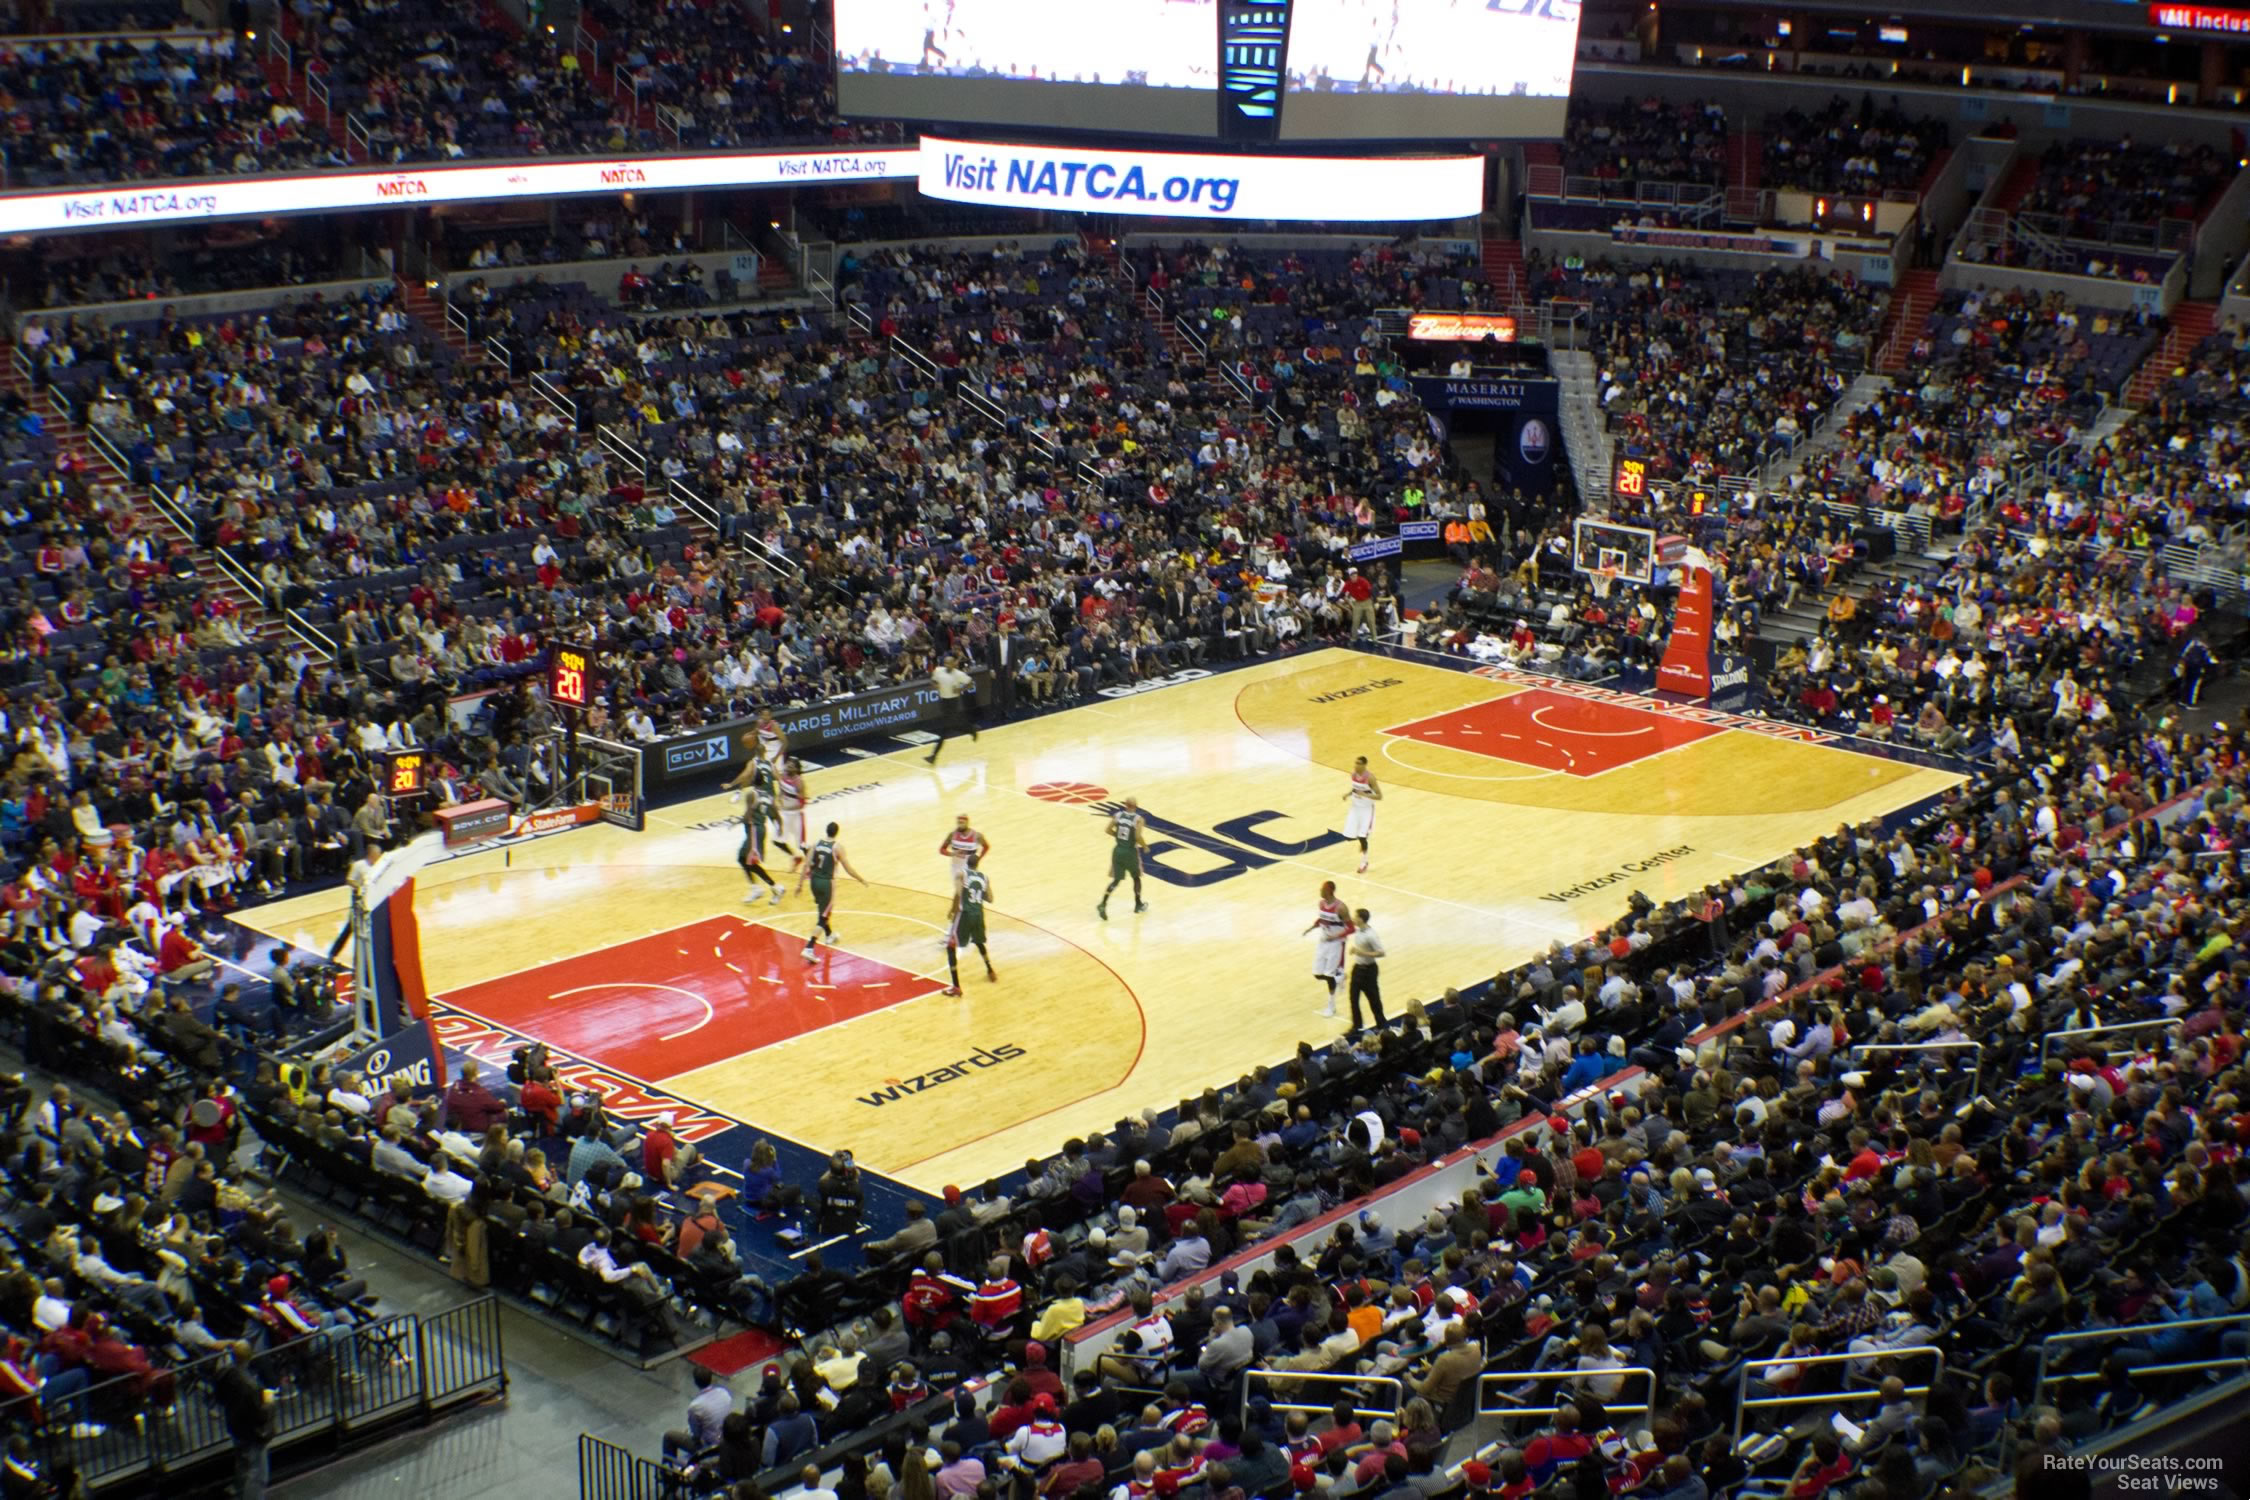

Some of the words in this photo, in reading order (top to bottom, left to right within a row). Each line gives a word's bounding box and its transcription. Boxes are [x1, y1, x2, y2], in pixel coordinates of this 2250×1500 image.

[601, 169, 646, 183] NATCA
[778, 159, 807, 175] Visit
[812, 158, 887, 175] NATCA.org
[377, 180, 428, 197] NATCA
[944, 153, 997, 192] Visit
[1006, 158, 1240, 212] NATCA.org
[64, 200, 105, 219] Visit
[112, 194, 217, 214] NATCA.org
[1409, 318, 1515, 338] Budweiser
[1446, 382, 1525, 396] MASERATI
[1458, 397, 1521, 407] WASHINGTON
[1620, 471, 1641, 493] 20
[1402, 524, 1438, 536] GEICO
[1376, 540, 1400, 552] GEICO
[557, 668, 581, 700] 20
[1711, 665, 1748, 692] SPALDING
[1467, 665, 1841, 744] WASHINGTON
[780, 715, 832, 735] ZARDS
[394, 771, 414, 789] 20
[1538, 871, 1631, 903] Verizon
[1621, 844, 1697, 873] Center
[855, 1043, 1028, 1107] wizards
